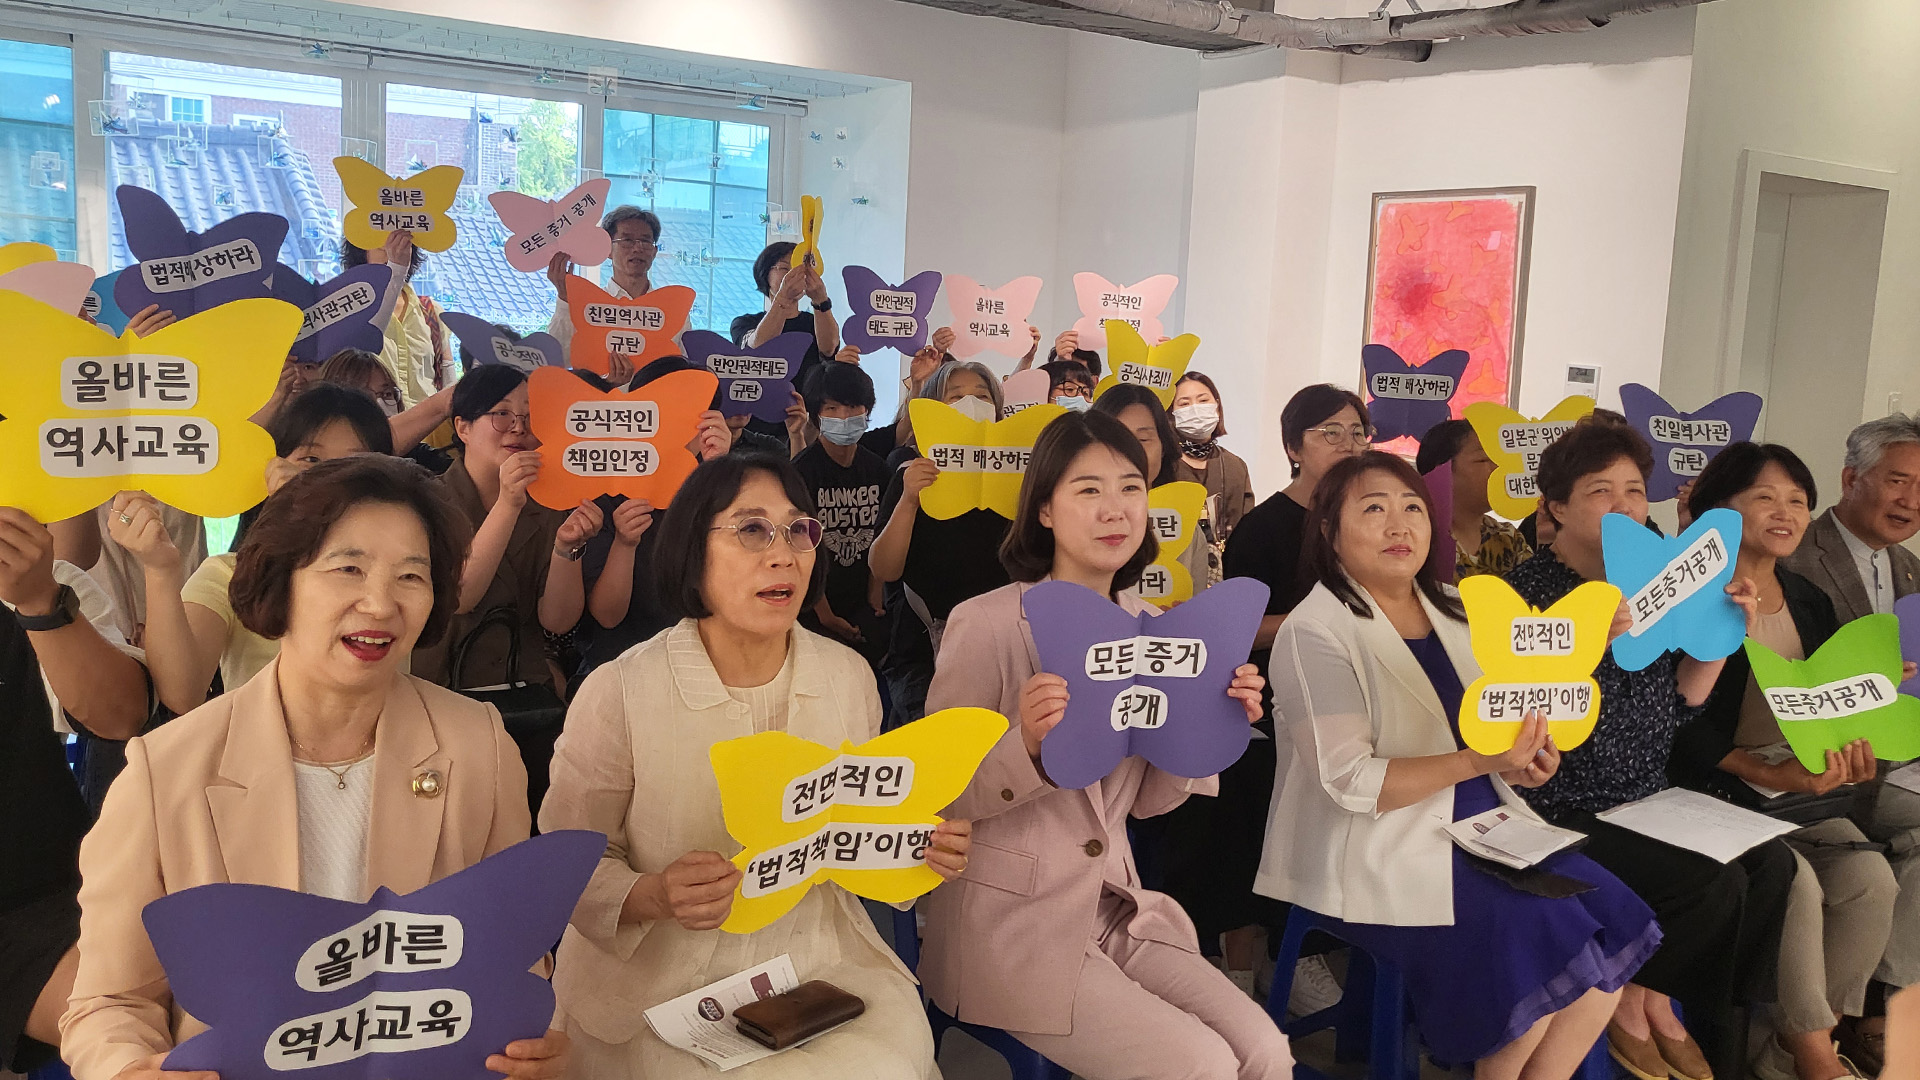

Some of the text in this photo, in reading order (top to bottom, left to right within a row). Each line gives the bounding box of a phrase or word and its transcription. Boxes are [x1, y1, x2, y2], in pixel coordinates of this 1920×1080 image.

[379, 188, 424, 207] 올바른
[370, 213, 430, 231] 역사교육
[519, 193, 597, 255] 모든 증거 공개
[299, 287, 371, 334] 역사관규탄
[875, 294, 913, 311] 반인권적
[976, 298, 1005, 315] 올바른
[1101, 293, 1142, 310] 공식적인
[588, 306, 662, 328] 친일역사관
[869, 320, 914, 336] 태도 규탄
[969, 322, 1010, 338] 역사교육
[610, 335, 641, 353] 규탄
[714, 357, 786, 376] 반인권적태도
[1121, 363, 1172, 387] 공식사죄!!
[72, 360, 190, 402] 올바른
[733, 383, 760, 399] 규탄
[1377, 375, 1450, 397] 법적 배상하라
[570, 409, 653, 432] 공식적인
[1653, 418, 1729, 441] 친일역사관
[46, 423, 209, 467] 역사교육
[568, 448, 649, 473] 책임인정
[932, 447, 965, 468] 법적
[1527, 453, 1541, 471] 문
[1674, 451, 1704, 471] 규탄
[818, 485, 880, 508] BUNKER
[1635, 537, 1722, 623] 모든증거공개
[1090, 641, 1201, 675] 모든 증거
[1770, 679, 1884, 715] 모든증거공개
[1118, 694, 1161, 726] 공개
[792, 764, 903, 815] 전면적인
[314, 922, 447, 987] 올바른
[278, 1000, 461, 1061] 역사교육
